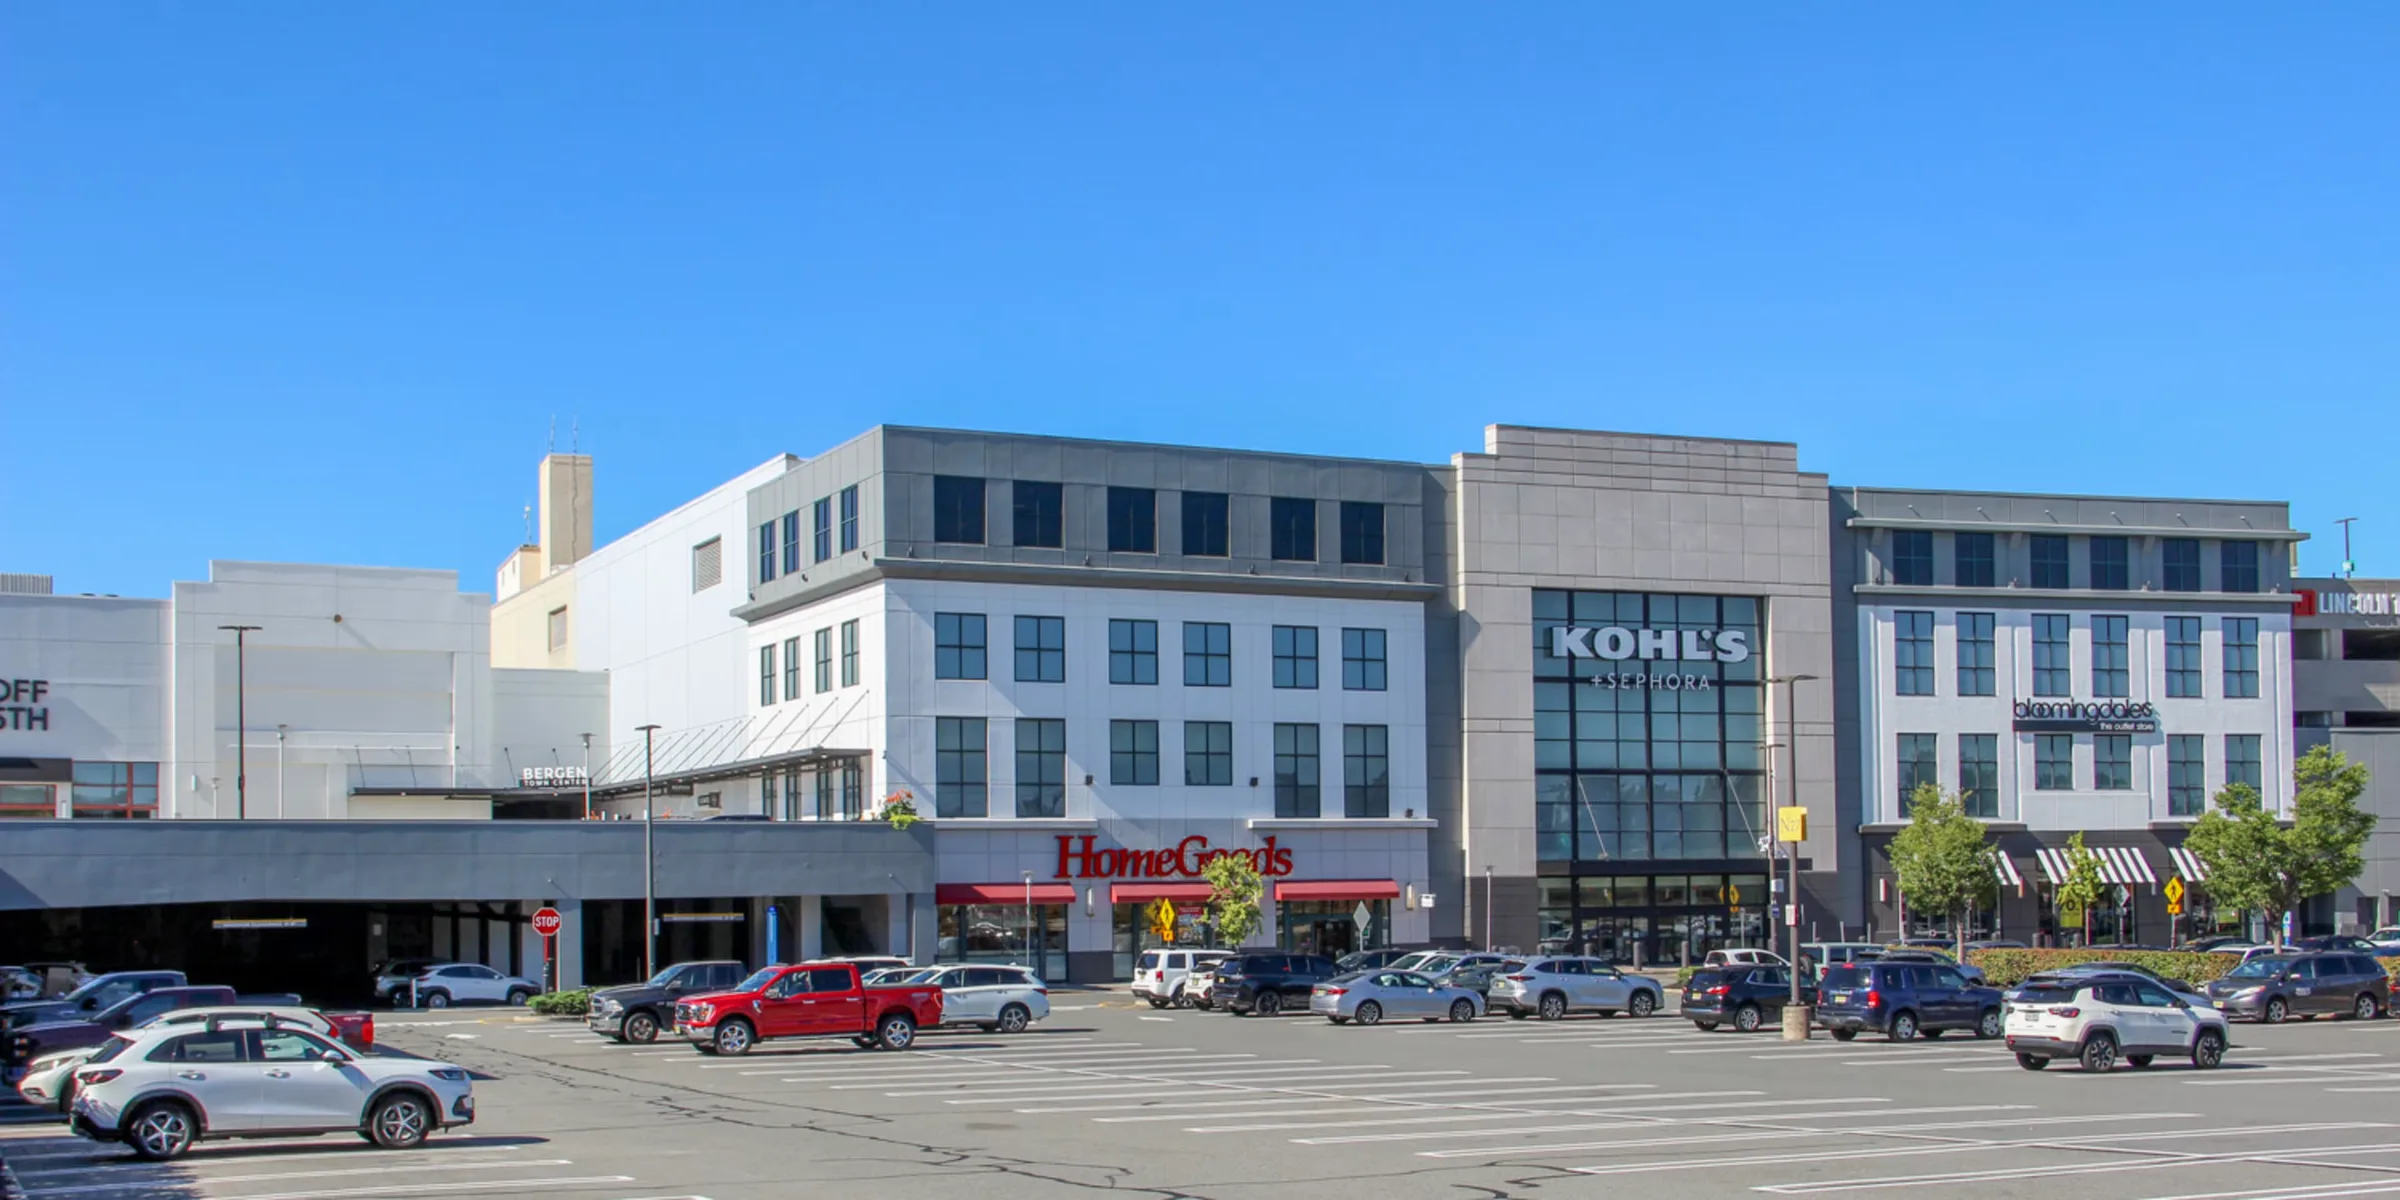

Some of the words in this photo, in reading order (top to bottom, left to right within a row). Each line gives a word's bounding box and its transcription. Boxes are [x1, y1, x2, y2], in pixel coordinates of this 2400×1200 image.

[2319, 592, 2389, 614] LINCOLN
[1553, 627, 1748, 662] KOHL'S
[2100, 722, 2113, 731] the
[2114, 722, 2135, 731] outlet
[2136, 722, 2154, 731] store
[523, 766, 587, 780] BERGEN
[535, 916, 560, 928] STOP
